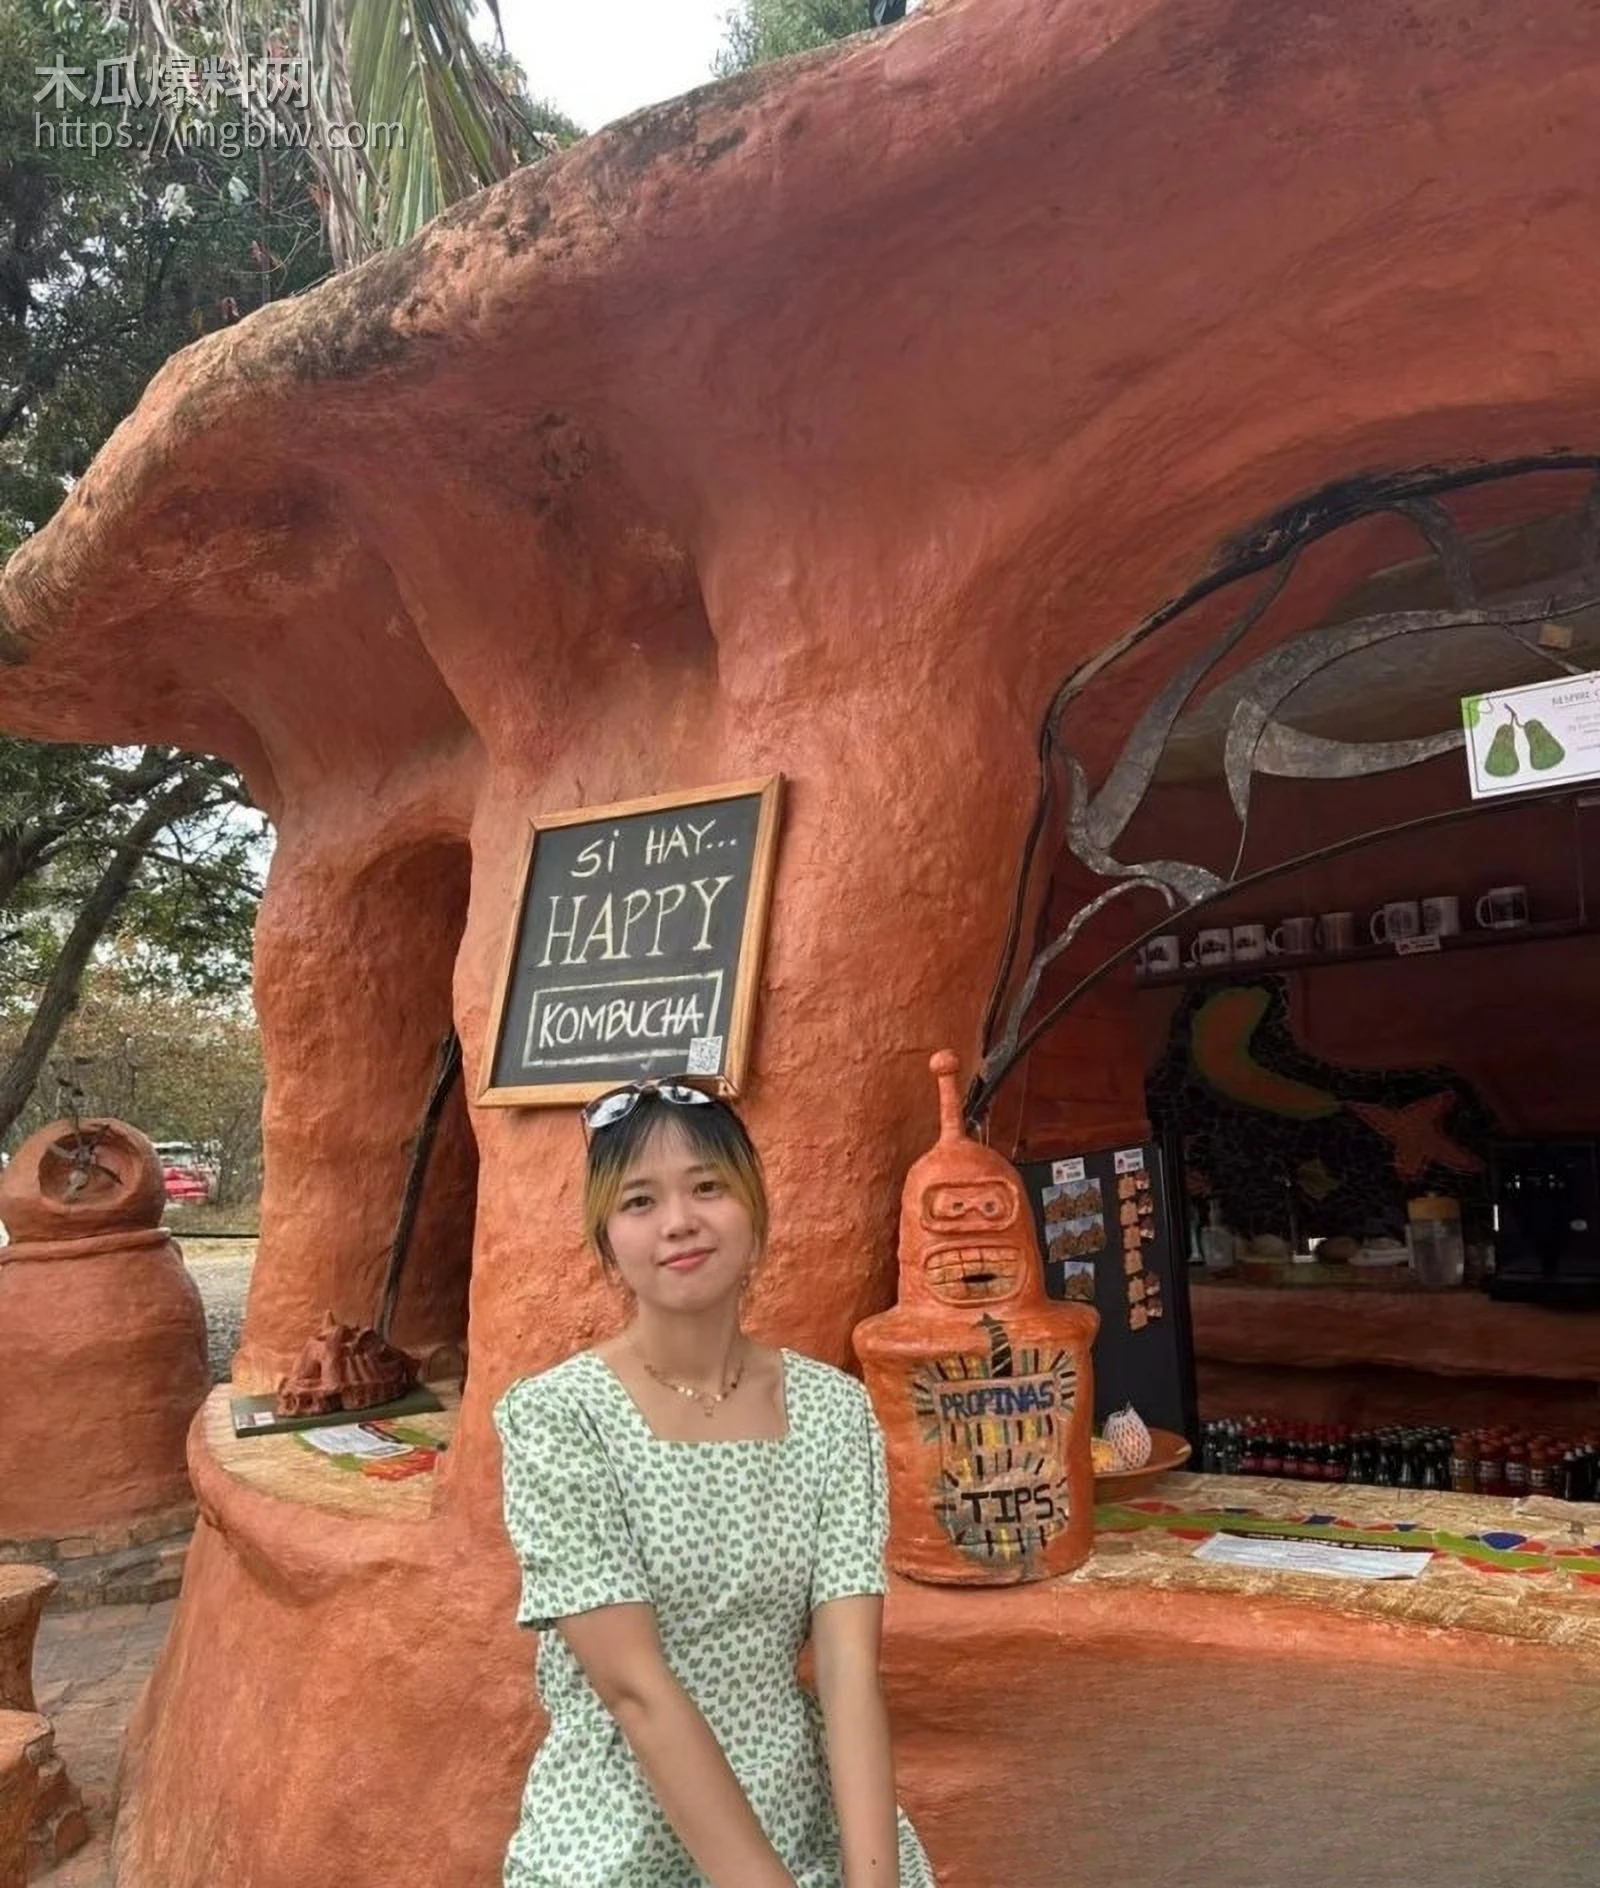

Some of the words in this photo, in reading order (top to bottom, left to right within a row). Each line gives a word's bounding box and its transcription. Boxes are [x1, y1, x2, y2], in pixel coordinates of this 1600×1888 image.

[645, 818, 737, 865] HAY...
[536, 875, 736, 968] HAPPY
[538, 995, 705, 1049] KOMBUCHA
[940, 1382, 1055, 1421] PROPINAS
[960, 1484, 1054, 1524] TIPS
